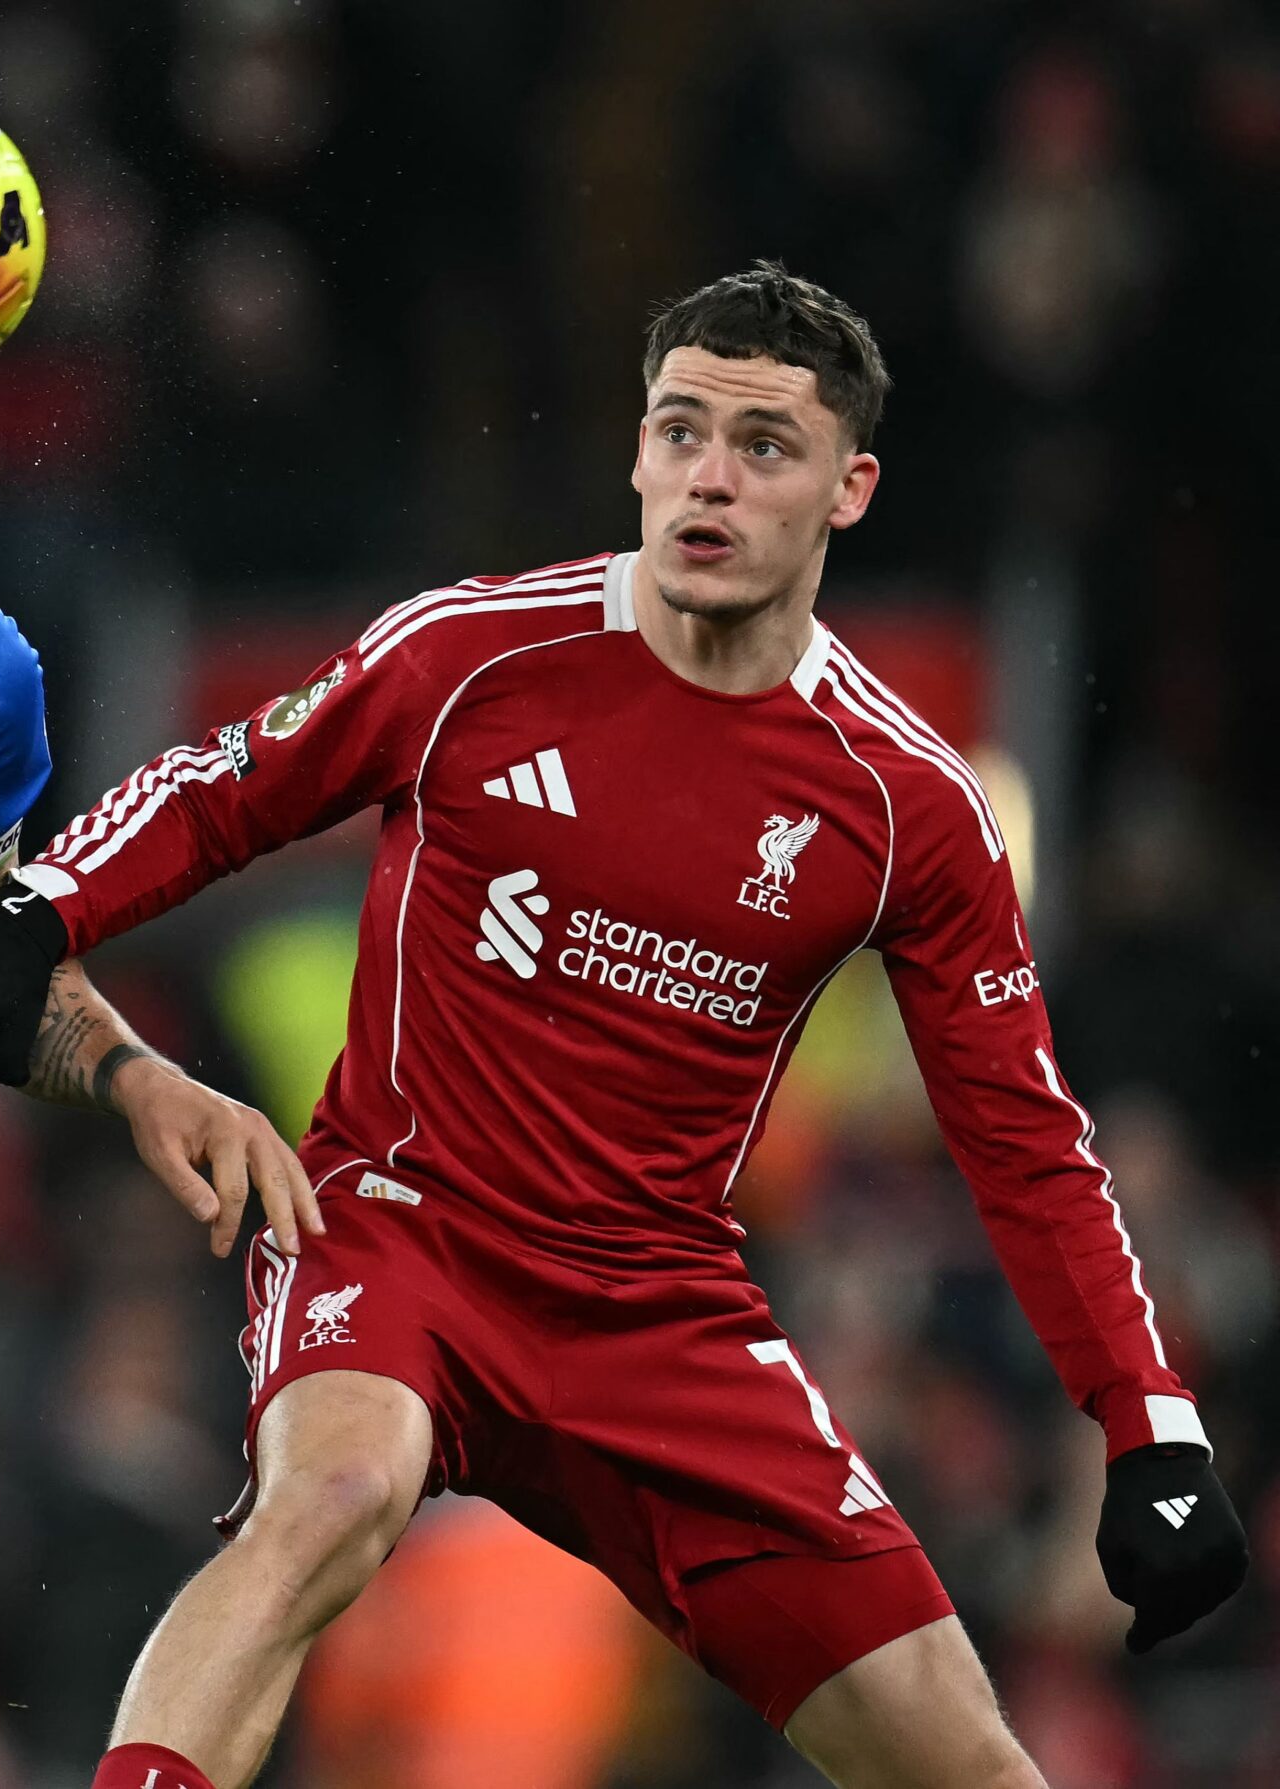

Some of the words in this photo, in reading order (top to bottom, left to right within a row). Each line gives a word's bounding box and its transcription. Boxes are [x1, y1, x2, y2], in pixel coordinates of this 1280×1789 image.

[736, 883, 791, 920] L.F.C.
[558, 946, 763, 1026] chartered
[566, 908, 769, 993] standard
[297, 1328, 357, 1352] L.F.C.
[745, 1338, 842, 1449] 7
